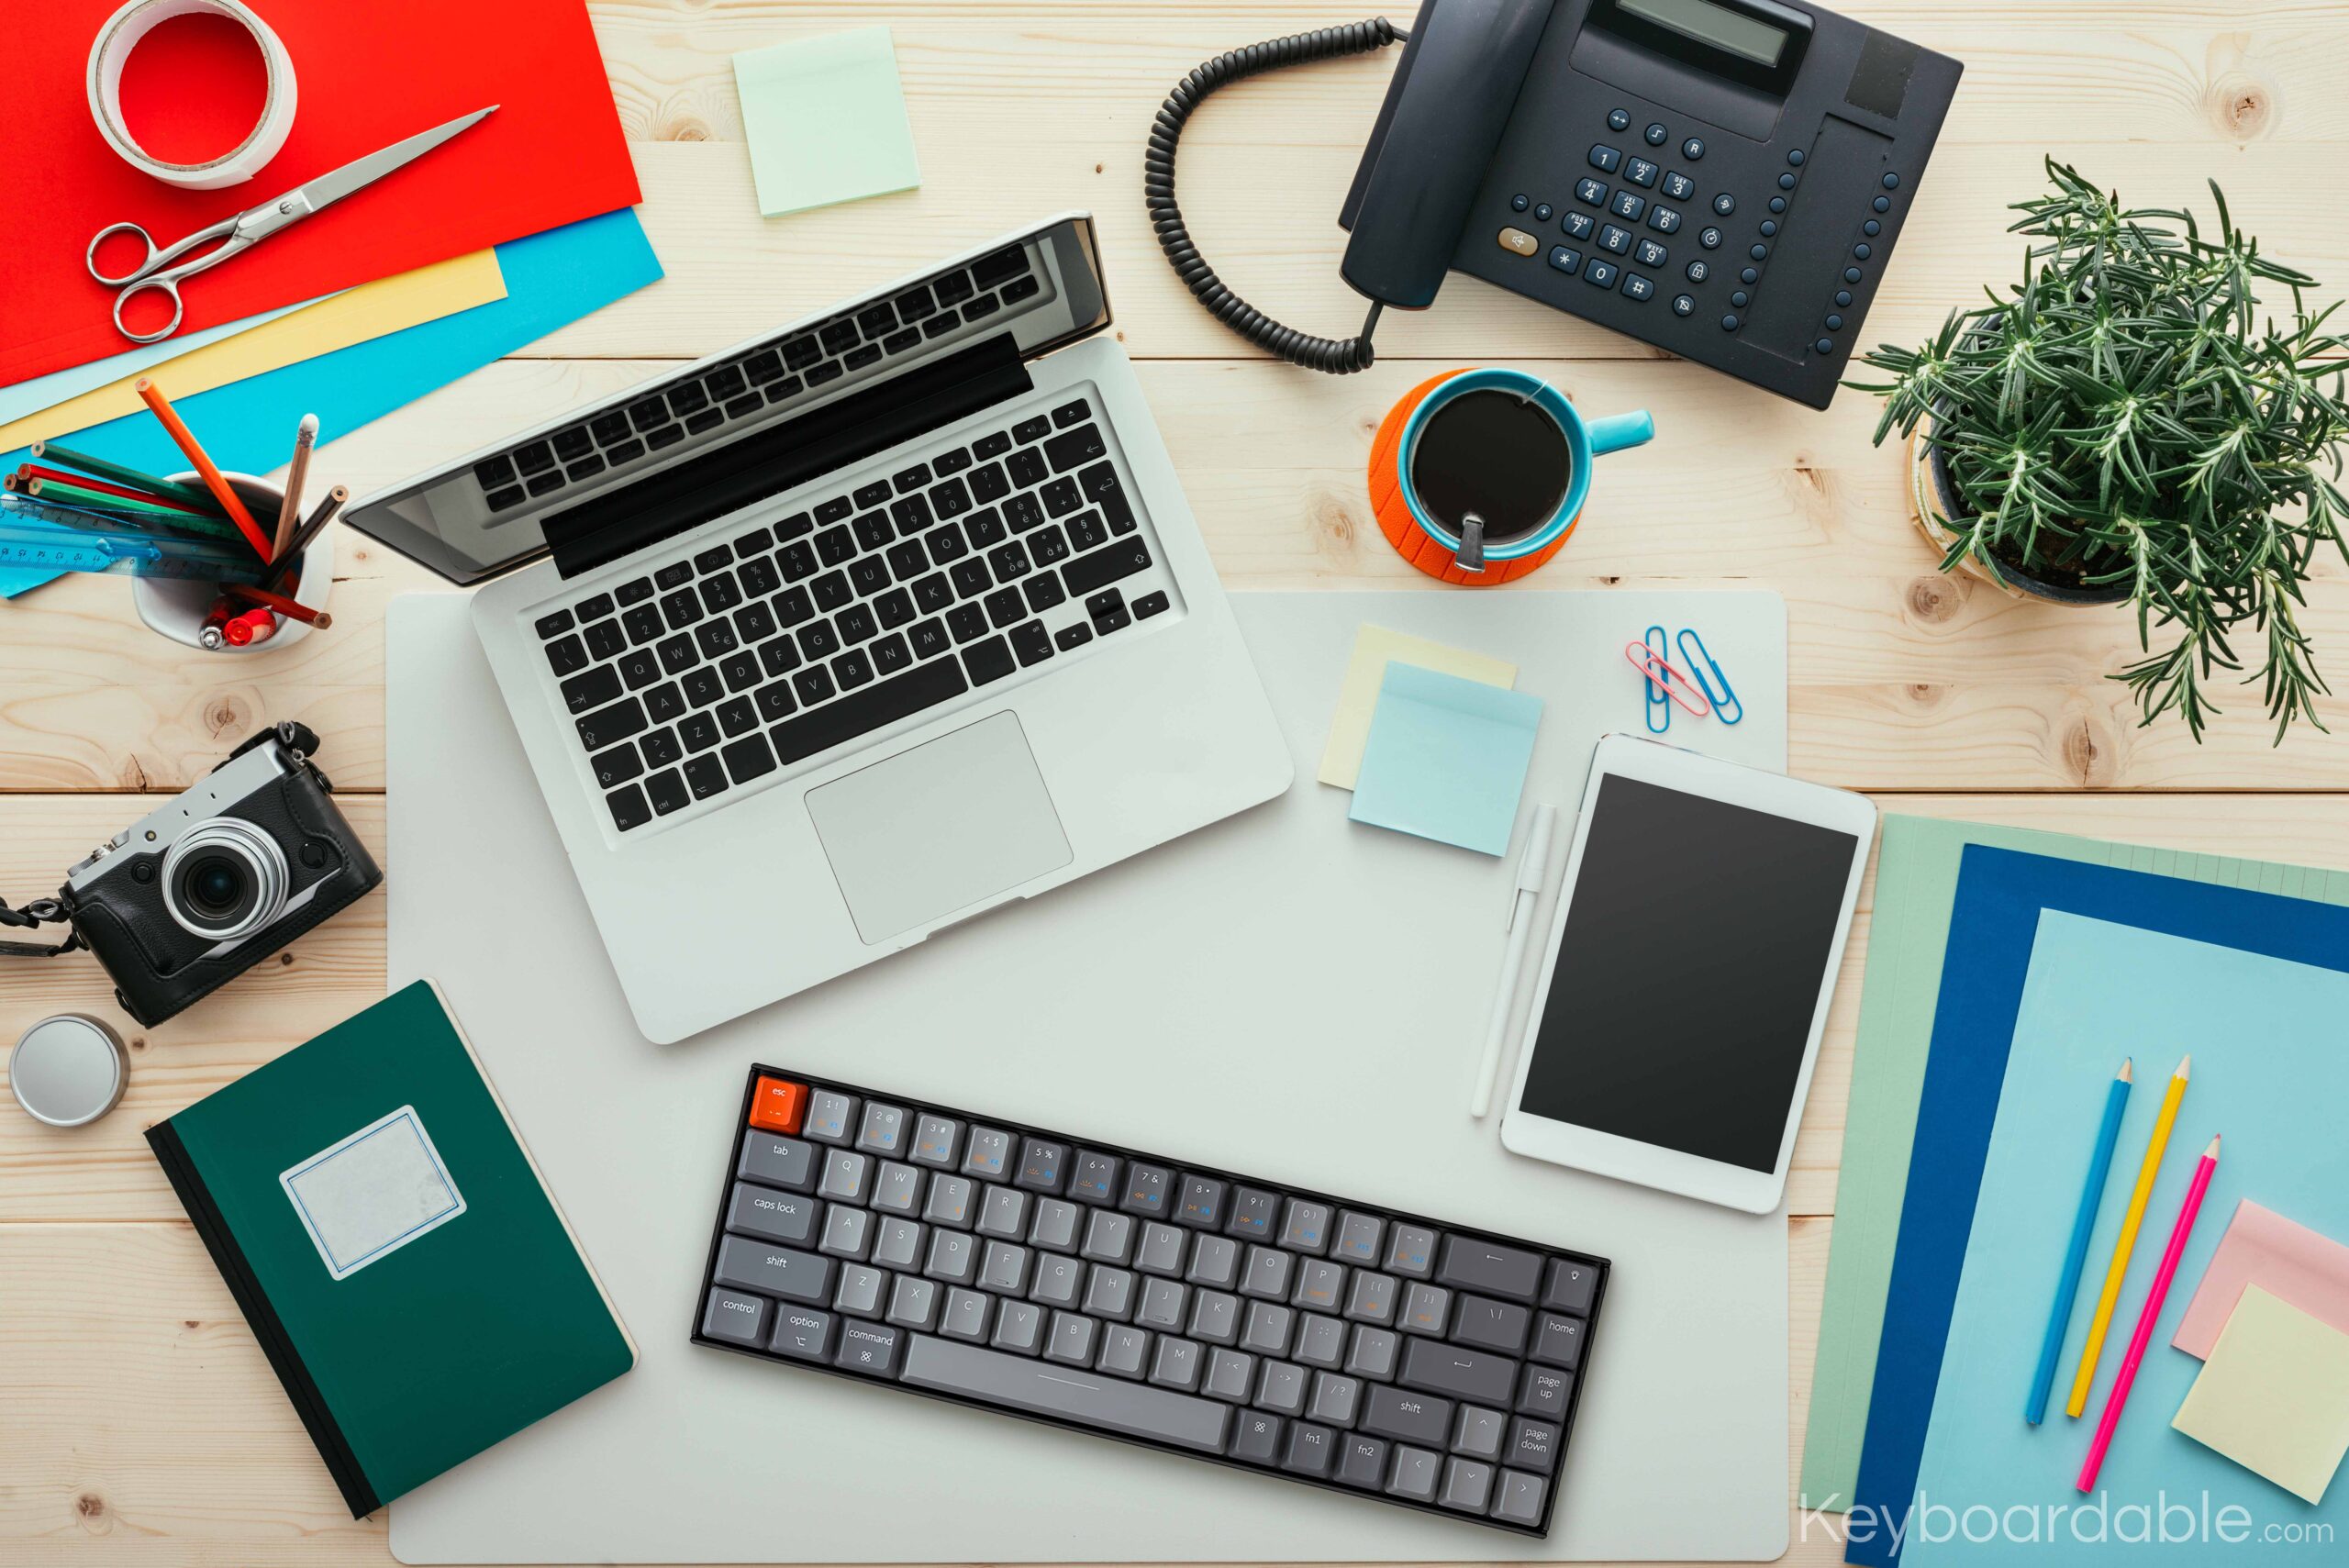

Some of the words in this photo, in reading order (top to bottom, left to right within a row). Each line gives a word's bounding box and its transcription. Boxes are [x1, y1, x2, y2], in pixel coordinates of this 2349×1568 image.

[1690, 142, 1699, 154] R
[1600, 153, 1609, 165] 1
[1637, 162, 1651, 172] ABC
[1634, 169, 1645, 181] 2
[1674, 176, 1688, 185] DEF
[1587, 182, 1599, 191] GHI
[1673, 183, 1684, 195] 3
[1585, 189, 1595, 200] 4
[1624, 195, 1636, 205] JKL
[1622, 202, 1632, 215] 5
[1660, 209, 1675, 219] MNO
[1571, 214, 1588, 225] PQRS
[1660, 217, 1671, 228] 6
[1572, 221, 1583, 233] 7
[1611, 228, 1624, 239] TUV
[1609, 236, 1620, 248] 8
[1646, 243, 1664, 254] WXYZ
[1646, 250, 1657, 262] 9
[1596, 267, 1607, 280] 0
[1632, 281, 1645, 295] #
[910, 515, 918, 525] 9
[980, 522, 988, 534] P
[872, 530, 881, 541] 8
[941, 538, 952, 550] O
[1056, 543, 1063, 553] #
[789, 550, 799, 560] &
[832, 547, 841, 557] 7
[750, 565, 762, 575] %
[796, 562, 803, 573] 6
[1017, 560, 1026, 569] @
[863, 568, 874, 581] U
[966, 572, 975, 583] L
[713, 581, 721, 591] $
[757, 577, 764, 588] 5
[826, 584, 834, 595] Y
[928, 586, 939, 599] K
[674, 597, 684, 607] £
[719, 593, 727, 603] 4
[787, 600, 796, 612] T
[892, 602, 898, 614] J
[679, 609, 688, 620] 3
[549, 620, 560, 628] esc
[750, 617, 759, 628] R
[851, 617, 862, 630] H
[641, 624, 651, 636] 2
[1032, 625, 1041, 634] alt
[711, 632, 719, 643] E
[723, 635, 732, 645] €
[813, 634, 823, 646] G
[922, 631, 936, 645] M
[670, 647, 684, 660] W
[774, 650, 783, 662] F
[885, 647, 896, 661] N
[634, 663, 646, 675] Q
[736, 666, 746, 678] D
[847, 664, 857, 676] B
[697, 682, 707, 693] S
[807, 678, 817, 691] V
[661, 697, 670, 709] A
[771, 695, 781, 706] C
[731, 710, 742, 723] X
[693, 726, 704, 739] Z
[658, 799, 670, 810] ctrl
[618, 817, 628, 826] fn
[772, 1087, 786, 1097] esc
[826, 1099, 831, 1108] 1
[875, 1110, 883, 1120] 2
[885, 1114, 895, 1124] @
[930, 1123, 937, 1132] 3
[940, 1126, 946, 1134] #
[983, 1136, 990, 1144] 4
[993, 1137, 999, 1148] $
[773, 1144, 789, 1156] tab
[1035, 1148, 1042, 1157] 5
[1044, 1149, 1053, 1160] %
[841, 1160, 852, 1173] Q
[1089, 1160, 1097, 1169] 6
[895, 1172, 907, 1183] W
[1141, 1172, 1149, 1182] 7
[1151, 1174, 1160, 1184] &
[948, 1184, 957, 1195] E
[1196, 1184, 1203, 1194] 8
[753, 1198, 775, 1213] caps
[776, 1202, 796, 1215] lock
[1001, 1195, 1009, 1207] R
[1250, 1197, 1257, 1206] 9
[1055, 1208, 1063, 1218] T
[843, 1218, 852, 1228] A
[1108, 1220, 1117, 1231] Y
[1254, 1218, 1264, 1227] F9
[896, 1229, 905, 1240] S
[1160, 1232, 1169, 1243] U
[949, 1240, 959, 1251] D
[765, 1254, 788, 1269] shift
[1002, 1253, 1011, 1263] F
[1265, 1257, 1275, 1268] O
[1055, 1265, 1064, 1276] G
[1319, 1269, 1328, 1279] P
[858, 1275, 867, 1286] Z
[1108, 1277, 1118, 1288] H
[910, 1287, 920, 1299] X
[1162, 1291, 1169, 1300] J
[722, 1299, 755, 1315] control
[963, 1300, 973, 1311] C
[1213, 1302, 1223, 1313] K
[1018, 1311, 1027, 1322] V
[1267, 1315, 1274, 1325] L
[789, 1316, 820, 1329] option
[1548, 1320, 1575, 1336] home
[1070, 1324, 1078, 1335] B
[848, 1327, 893, 1347] command
[1122, 1336, 1131, 1347] N
[1174, 1348, 1186, 1360] M
[1537, 1375, 1561, 1388] page
[1340, 1386, 1346, 1396] ?
[1540, 1388, 1553, 1400] up
[1400, 1401, 1422, 1415] shift
[1305, 1431, 1320, 1445] fn1
[1525, 1427, 1548, 1441] page
[1357, 1443, 1375, 1457] fn2
[1520, 1439, 1548, 1453] down
